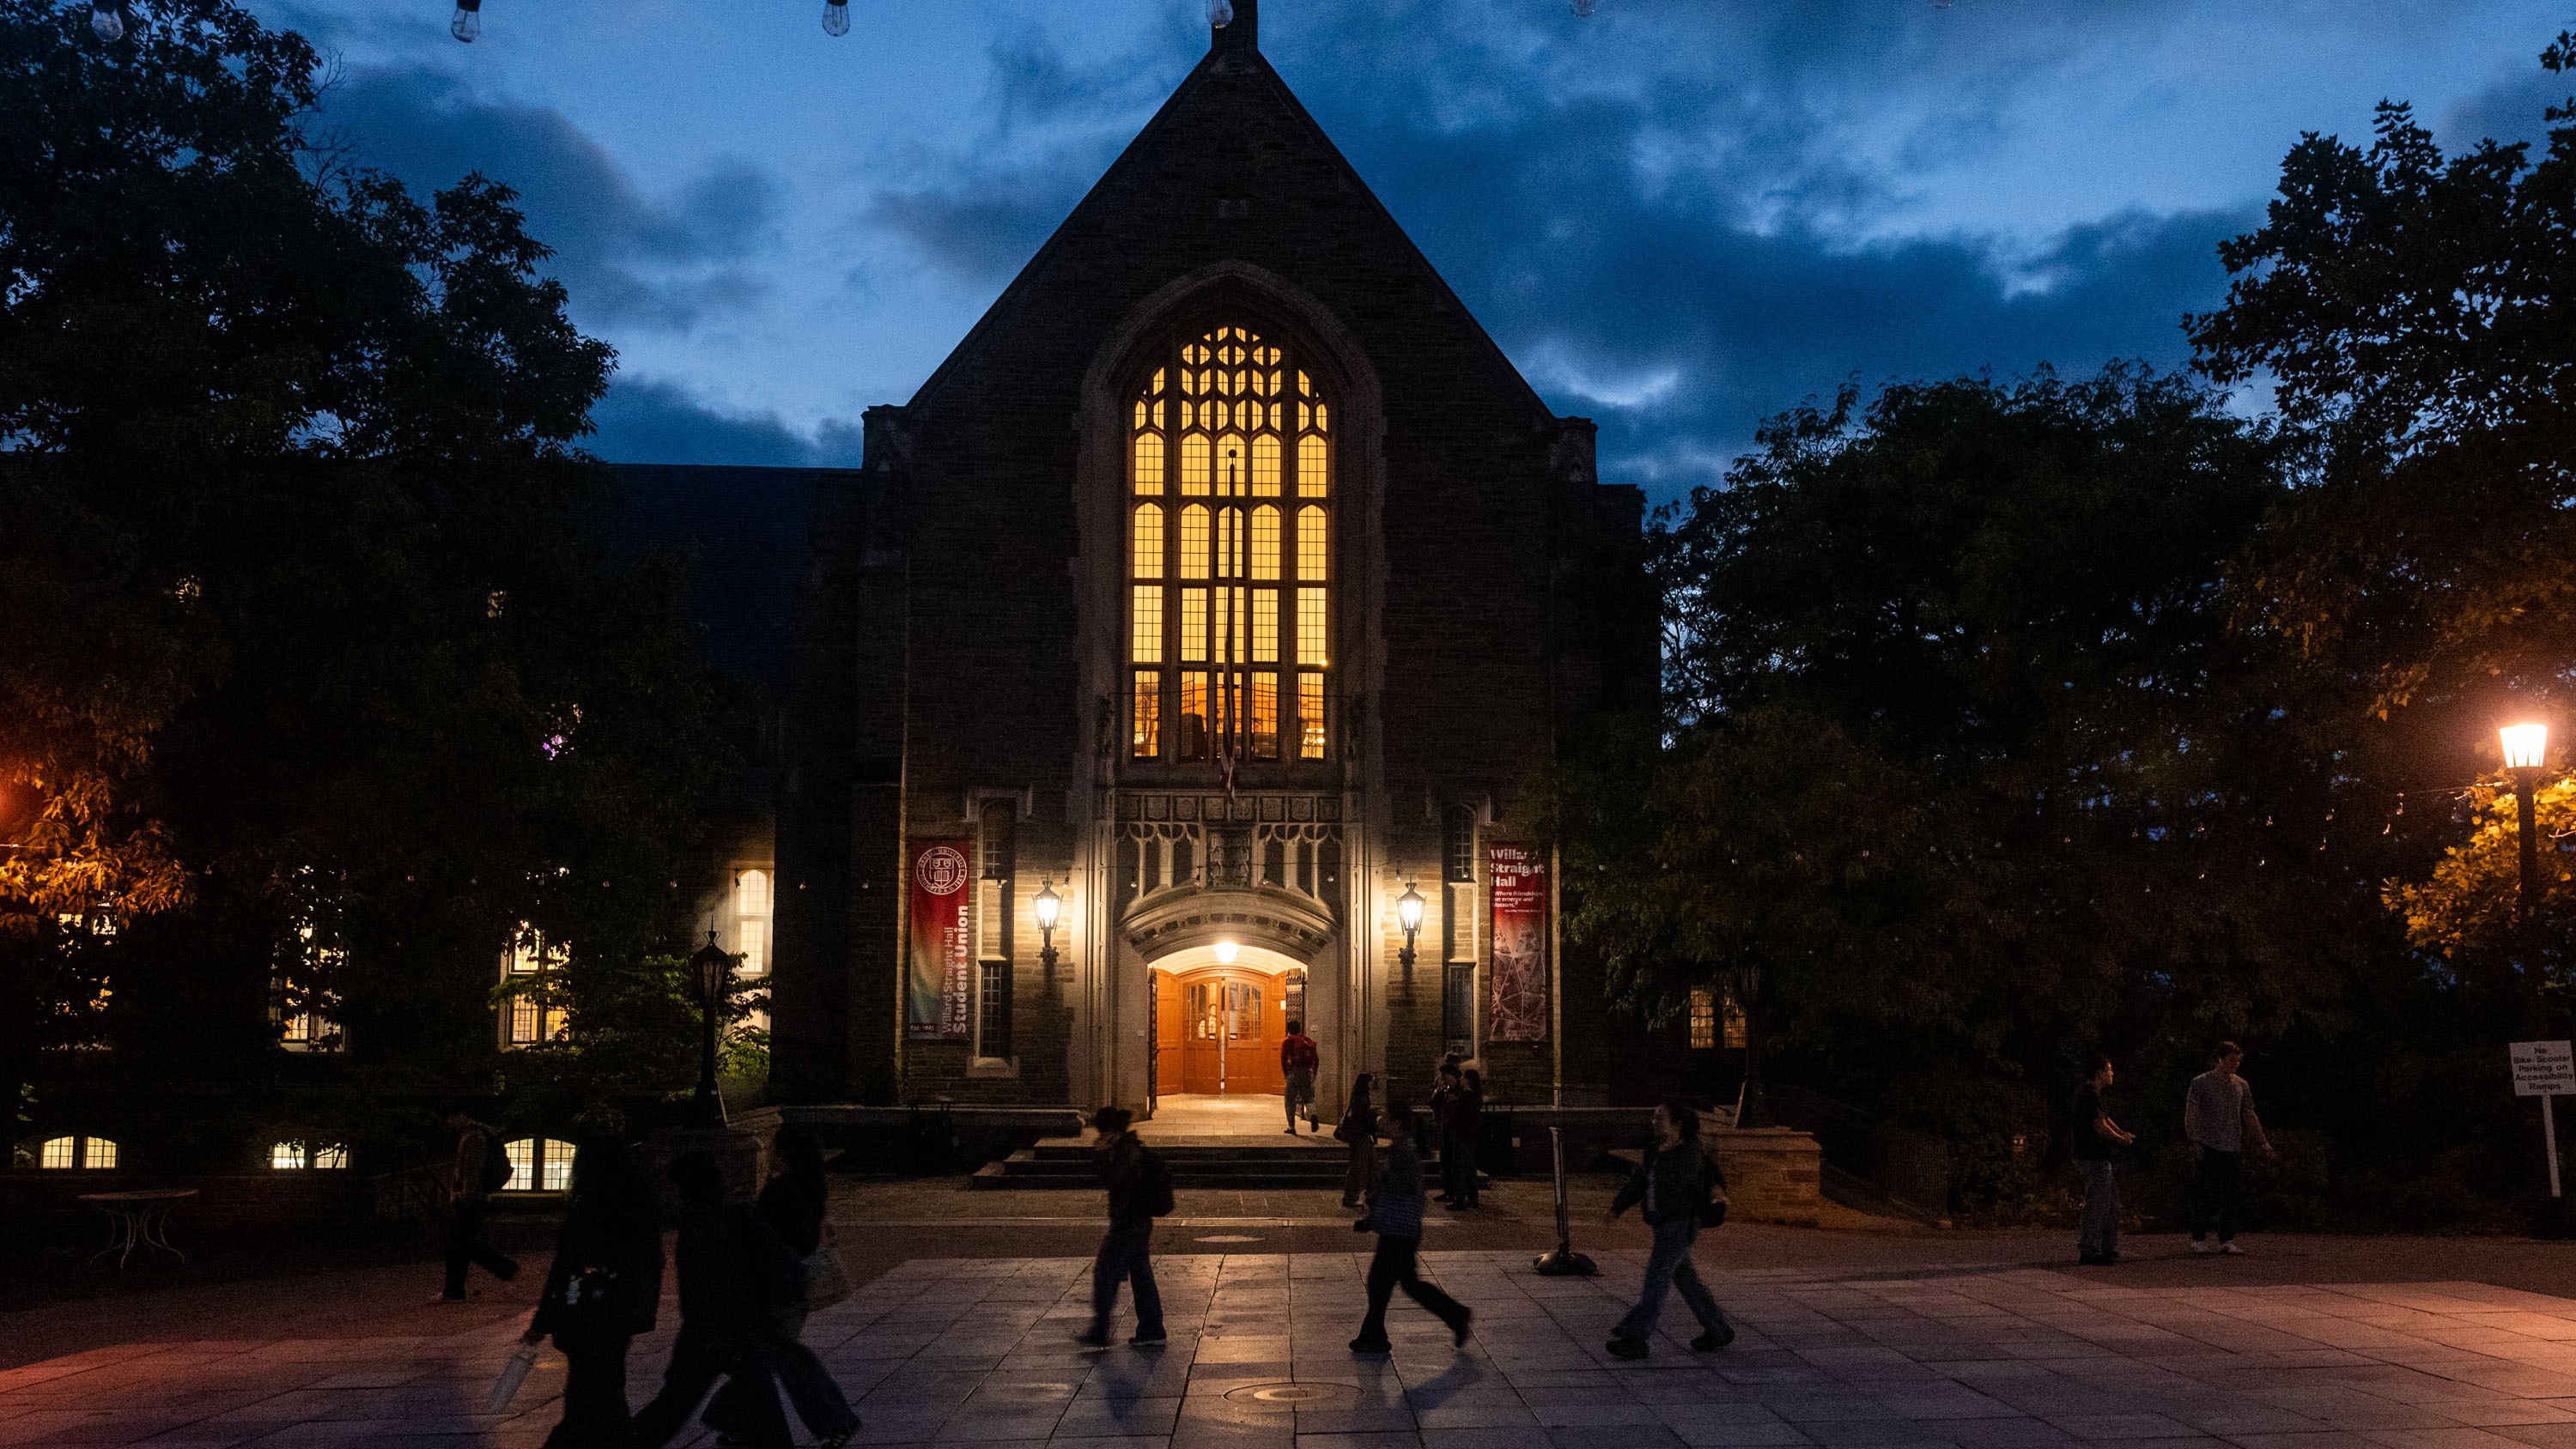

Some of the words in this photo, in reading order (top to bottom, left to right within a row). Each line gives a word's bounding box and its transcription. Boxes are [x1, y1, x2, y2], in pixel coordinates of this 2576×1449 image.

[1490, 876, 1516, 887] Hall
[945, 926, 954, 946] Hall
[953, 905, 969, 957] Union
[943, 950, 956, 992] Straight
[942, 995, 952, 1033] Willard
[953, 961, 968, 1034] Student
